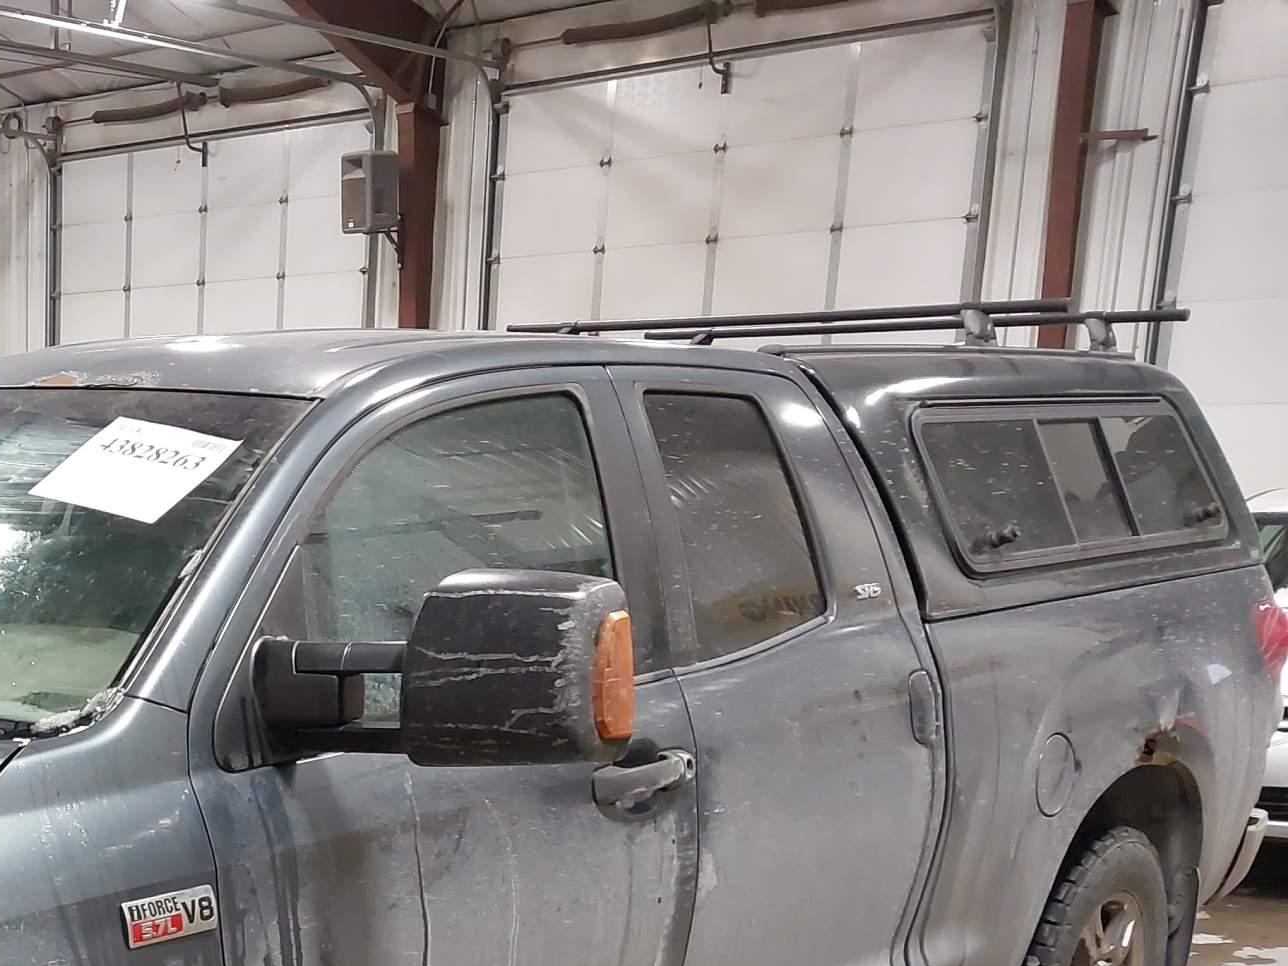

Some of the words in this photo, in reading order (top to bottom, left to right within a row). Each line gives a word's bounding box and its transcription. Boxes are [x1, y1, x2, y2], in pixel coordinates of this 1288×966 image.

[99, 437, 207, 471] 43828263
[181, 895, 214, 924] V8
[141, 917, 178, 938] 5.7L
